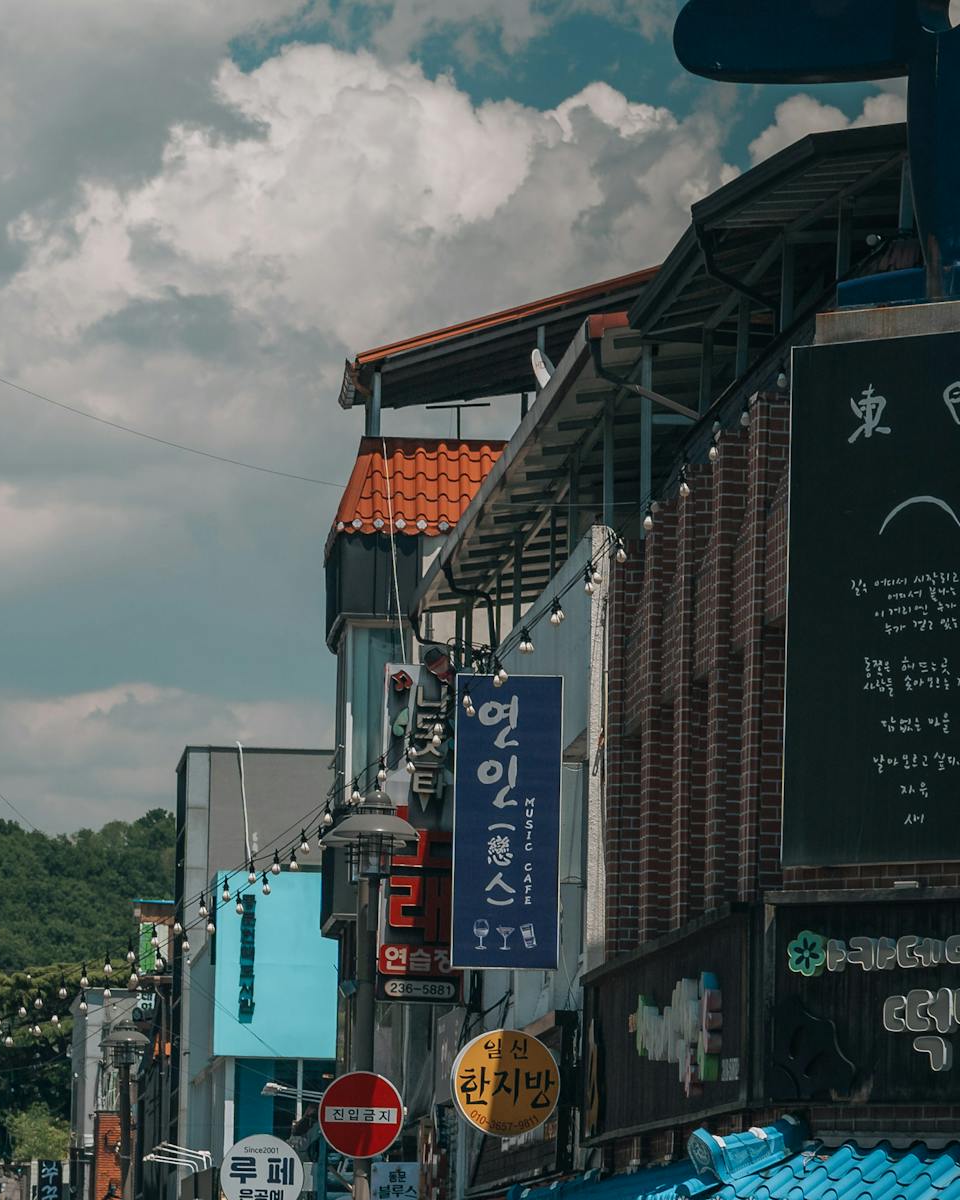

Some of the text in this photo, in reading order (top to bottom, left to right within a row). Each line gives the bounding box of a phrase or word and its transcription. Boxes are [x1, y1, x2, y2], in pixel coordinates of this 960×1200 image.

[864, 678, 894, 697] 사람들
[523, 797, 535, 905] MUSIC CAFE
[390, 983, 451, 996] 236-5881
[459, 1066, 555, 1109] 한지방
[332, 1108, 391, 1123] 진입금지
[243, 1146, 279, 1155] Since2001
